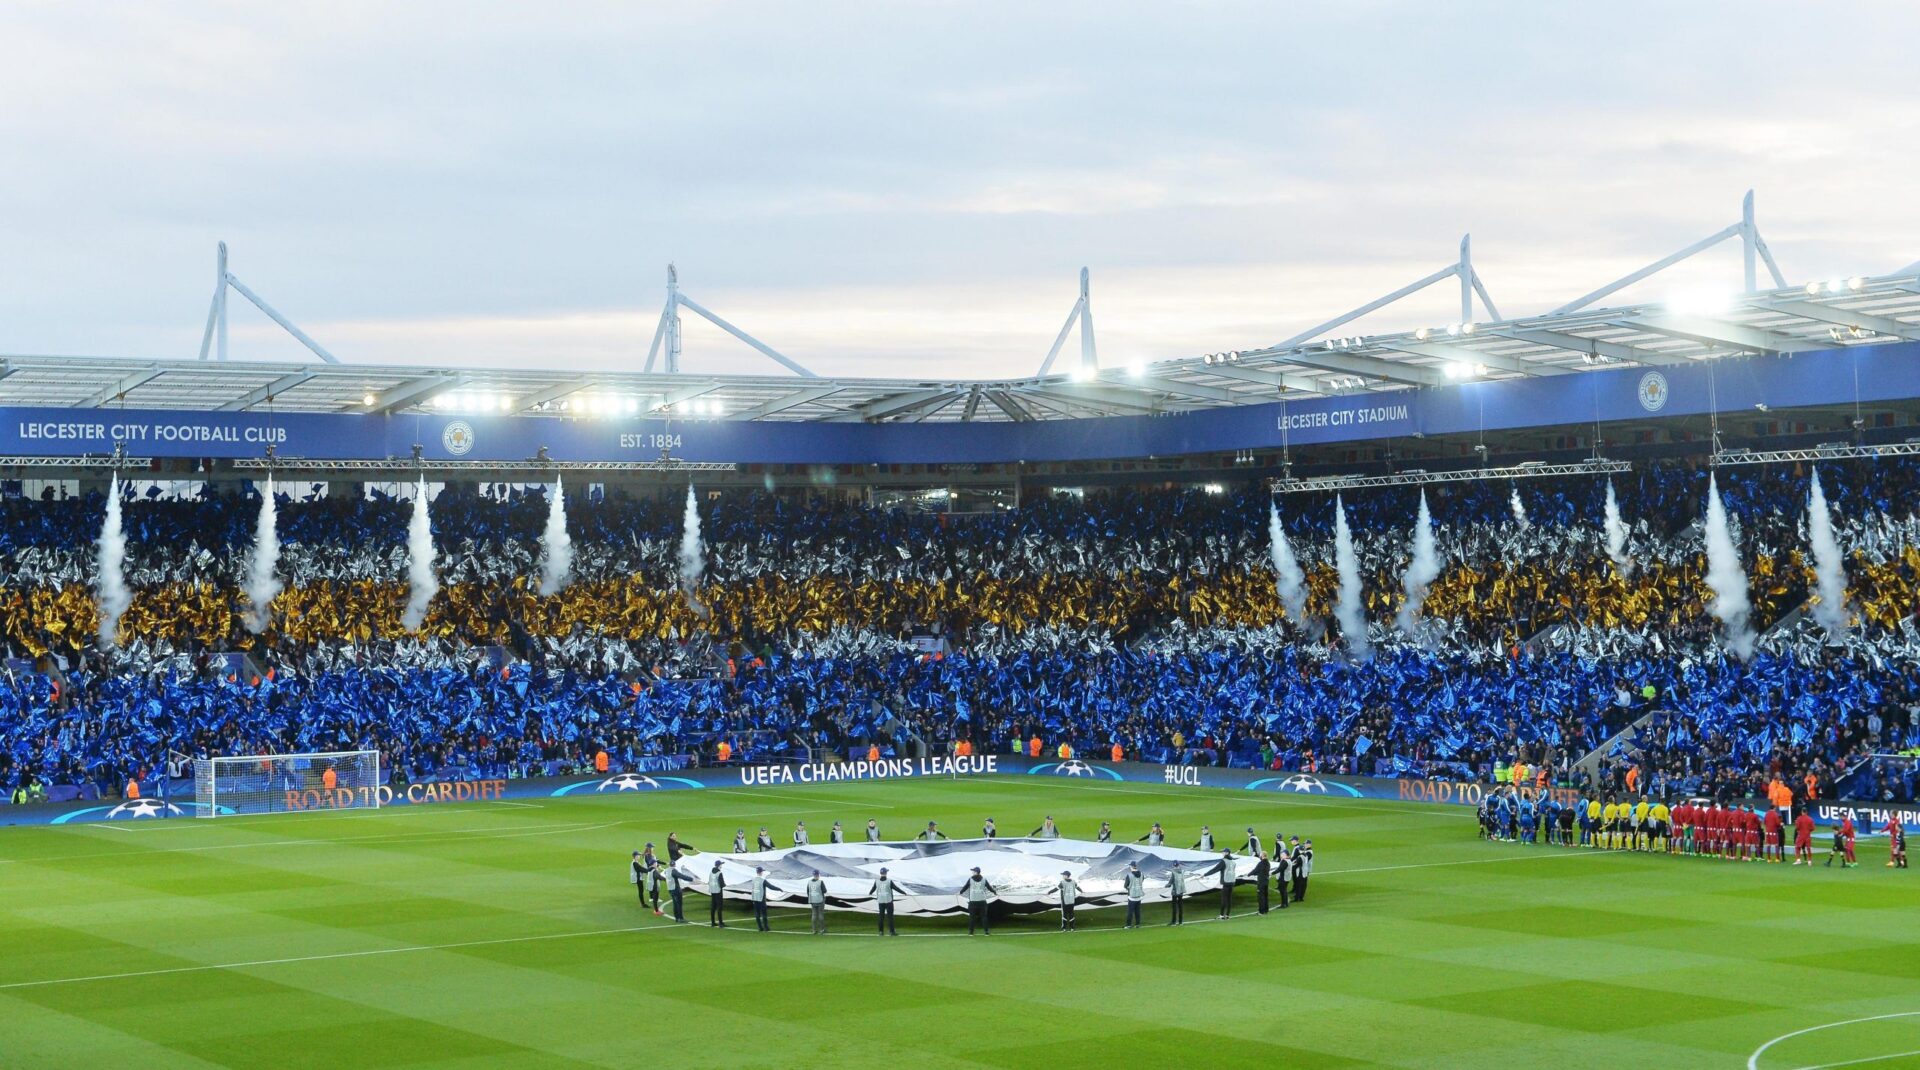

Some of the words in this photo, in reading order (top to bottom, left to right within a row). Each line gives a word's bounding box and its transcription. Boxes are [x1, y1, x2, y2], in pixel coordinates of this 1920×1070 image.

[1277, 412, 1328, 430] LEICESTER
[1330, 410, 1355, 426] CITY
[1357, 405, 1408, 423] STADIUM
[19, 422, 105, 440] LEICESTER
[110, 424, 148, 441] CITY
[154, 425, 240, 442] FOOTBALL
[244, 427, 287, 443] CLUB
[620, 434, 645, 447] EST.
[649, 434, 681, 448] 1884
[741, 765, 793, 785] UEFA
[799, 758, 912, 782] CHAMPIONS
[921, 755, 997, 775] LEAGUE
[1164, 764, 1201, 786] #UCL
[286, 788, 354, 810] ROAD
[359, 785, 393, 805] TO
[407, 779, 506, 803] CARDIFF
[1400, 779, 1451, 801] ROAD
[1456, 782, 1481, 805] TO
